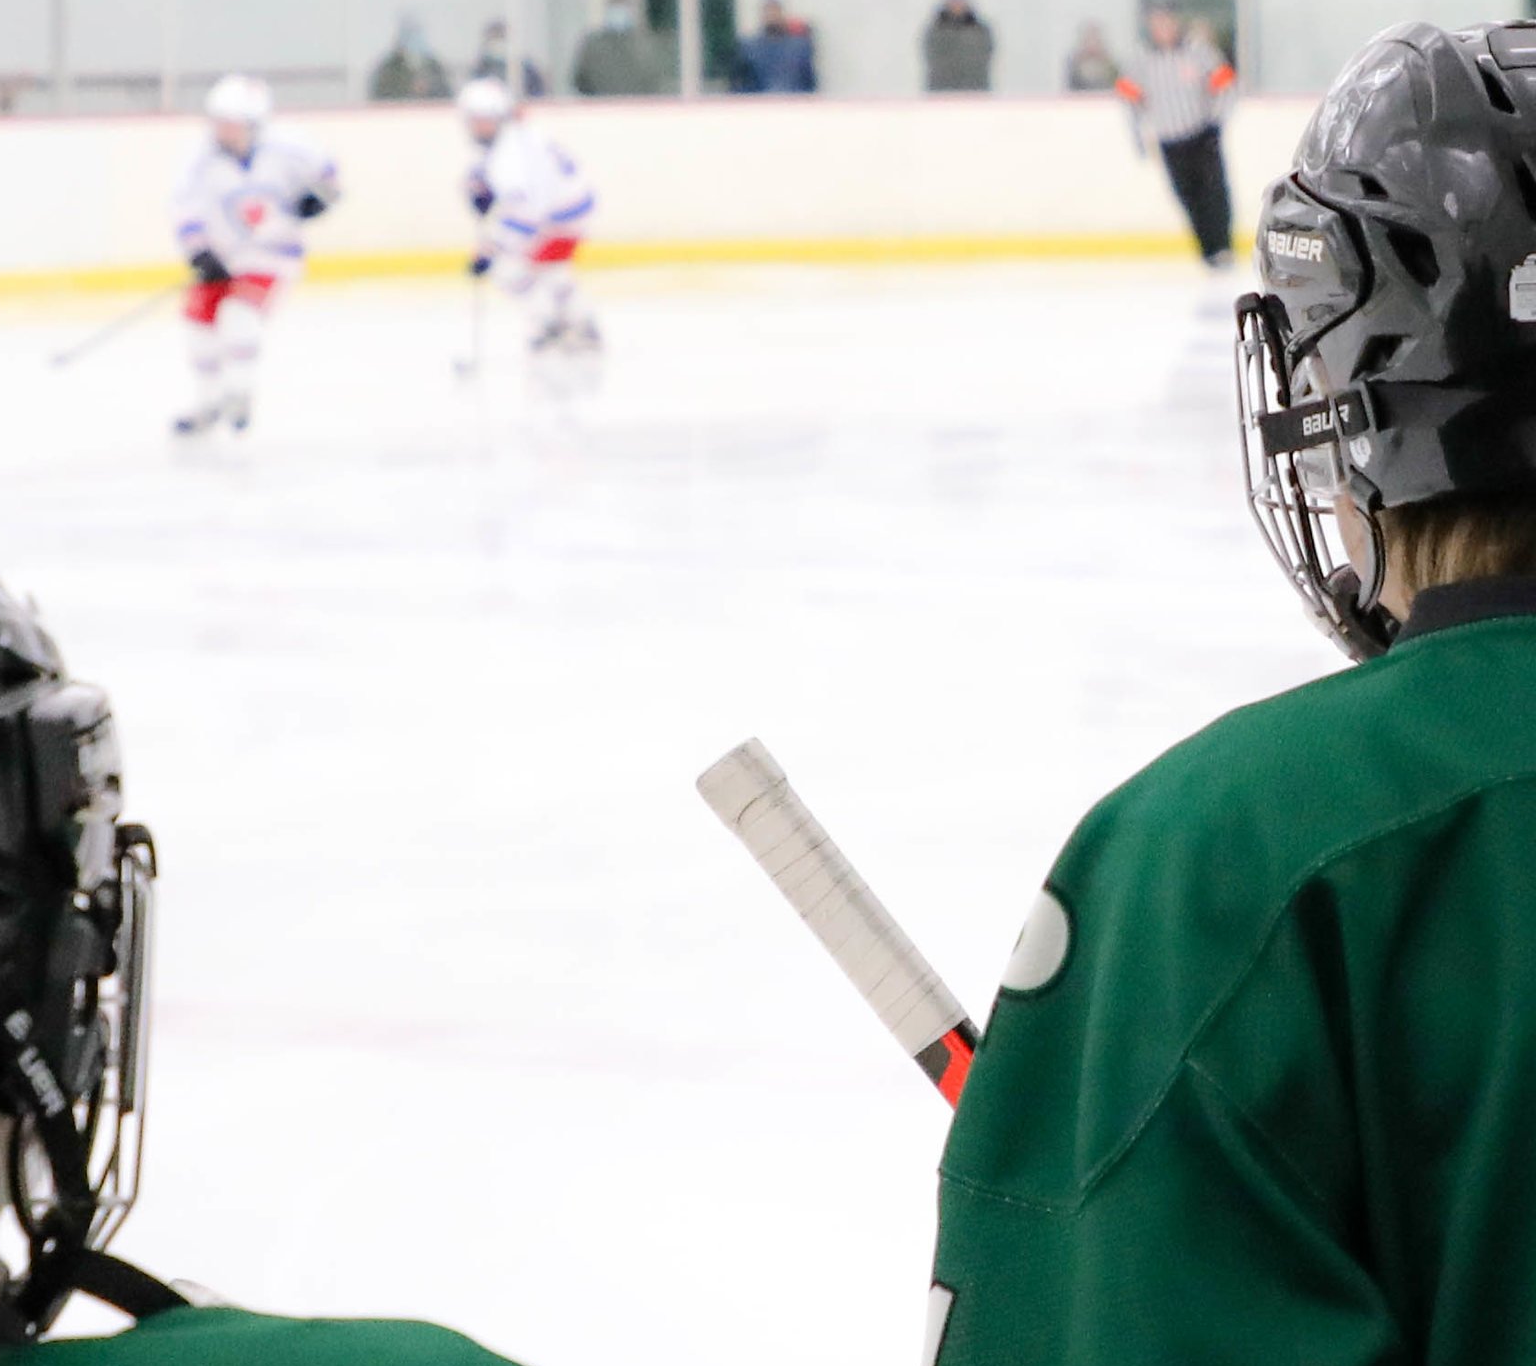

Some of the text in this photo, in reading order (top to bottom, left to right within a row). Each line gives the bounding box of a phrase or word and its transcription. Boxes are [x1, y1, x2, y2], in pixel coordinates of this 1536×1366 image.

[1267, 230, 1324, 263] BAUER
[1302, 404, 1351, 436] BAUR
[5, 1009, 67, 1118] BUER
